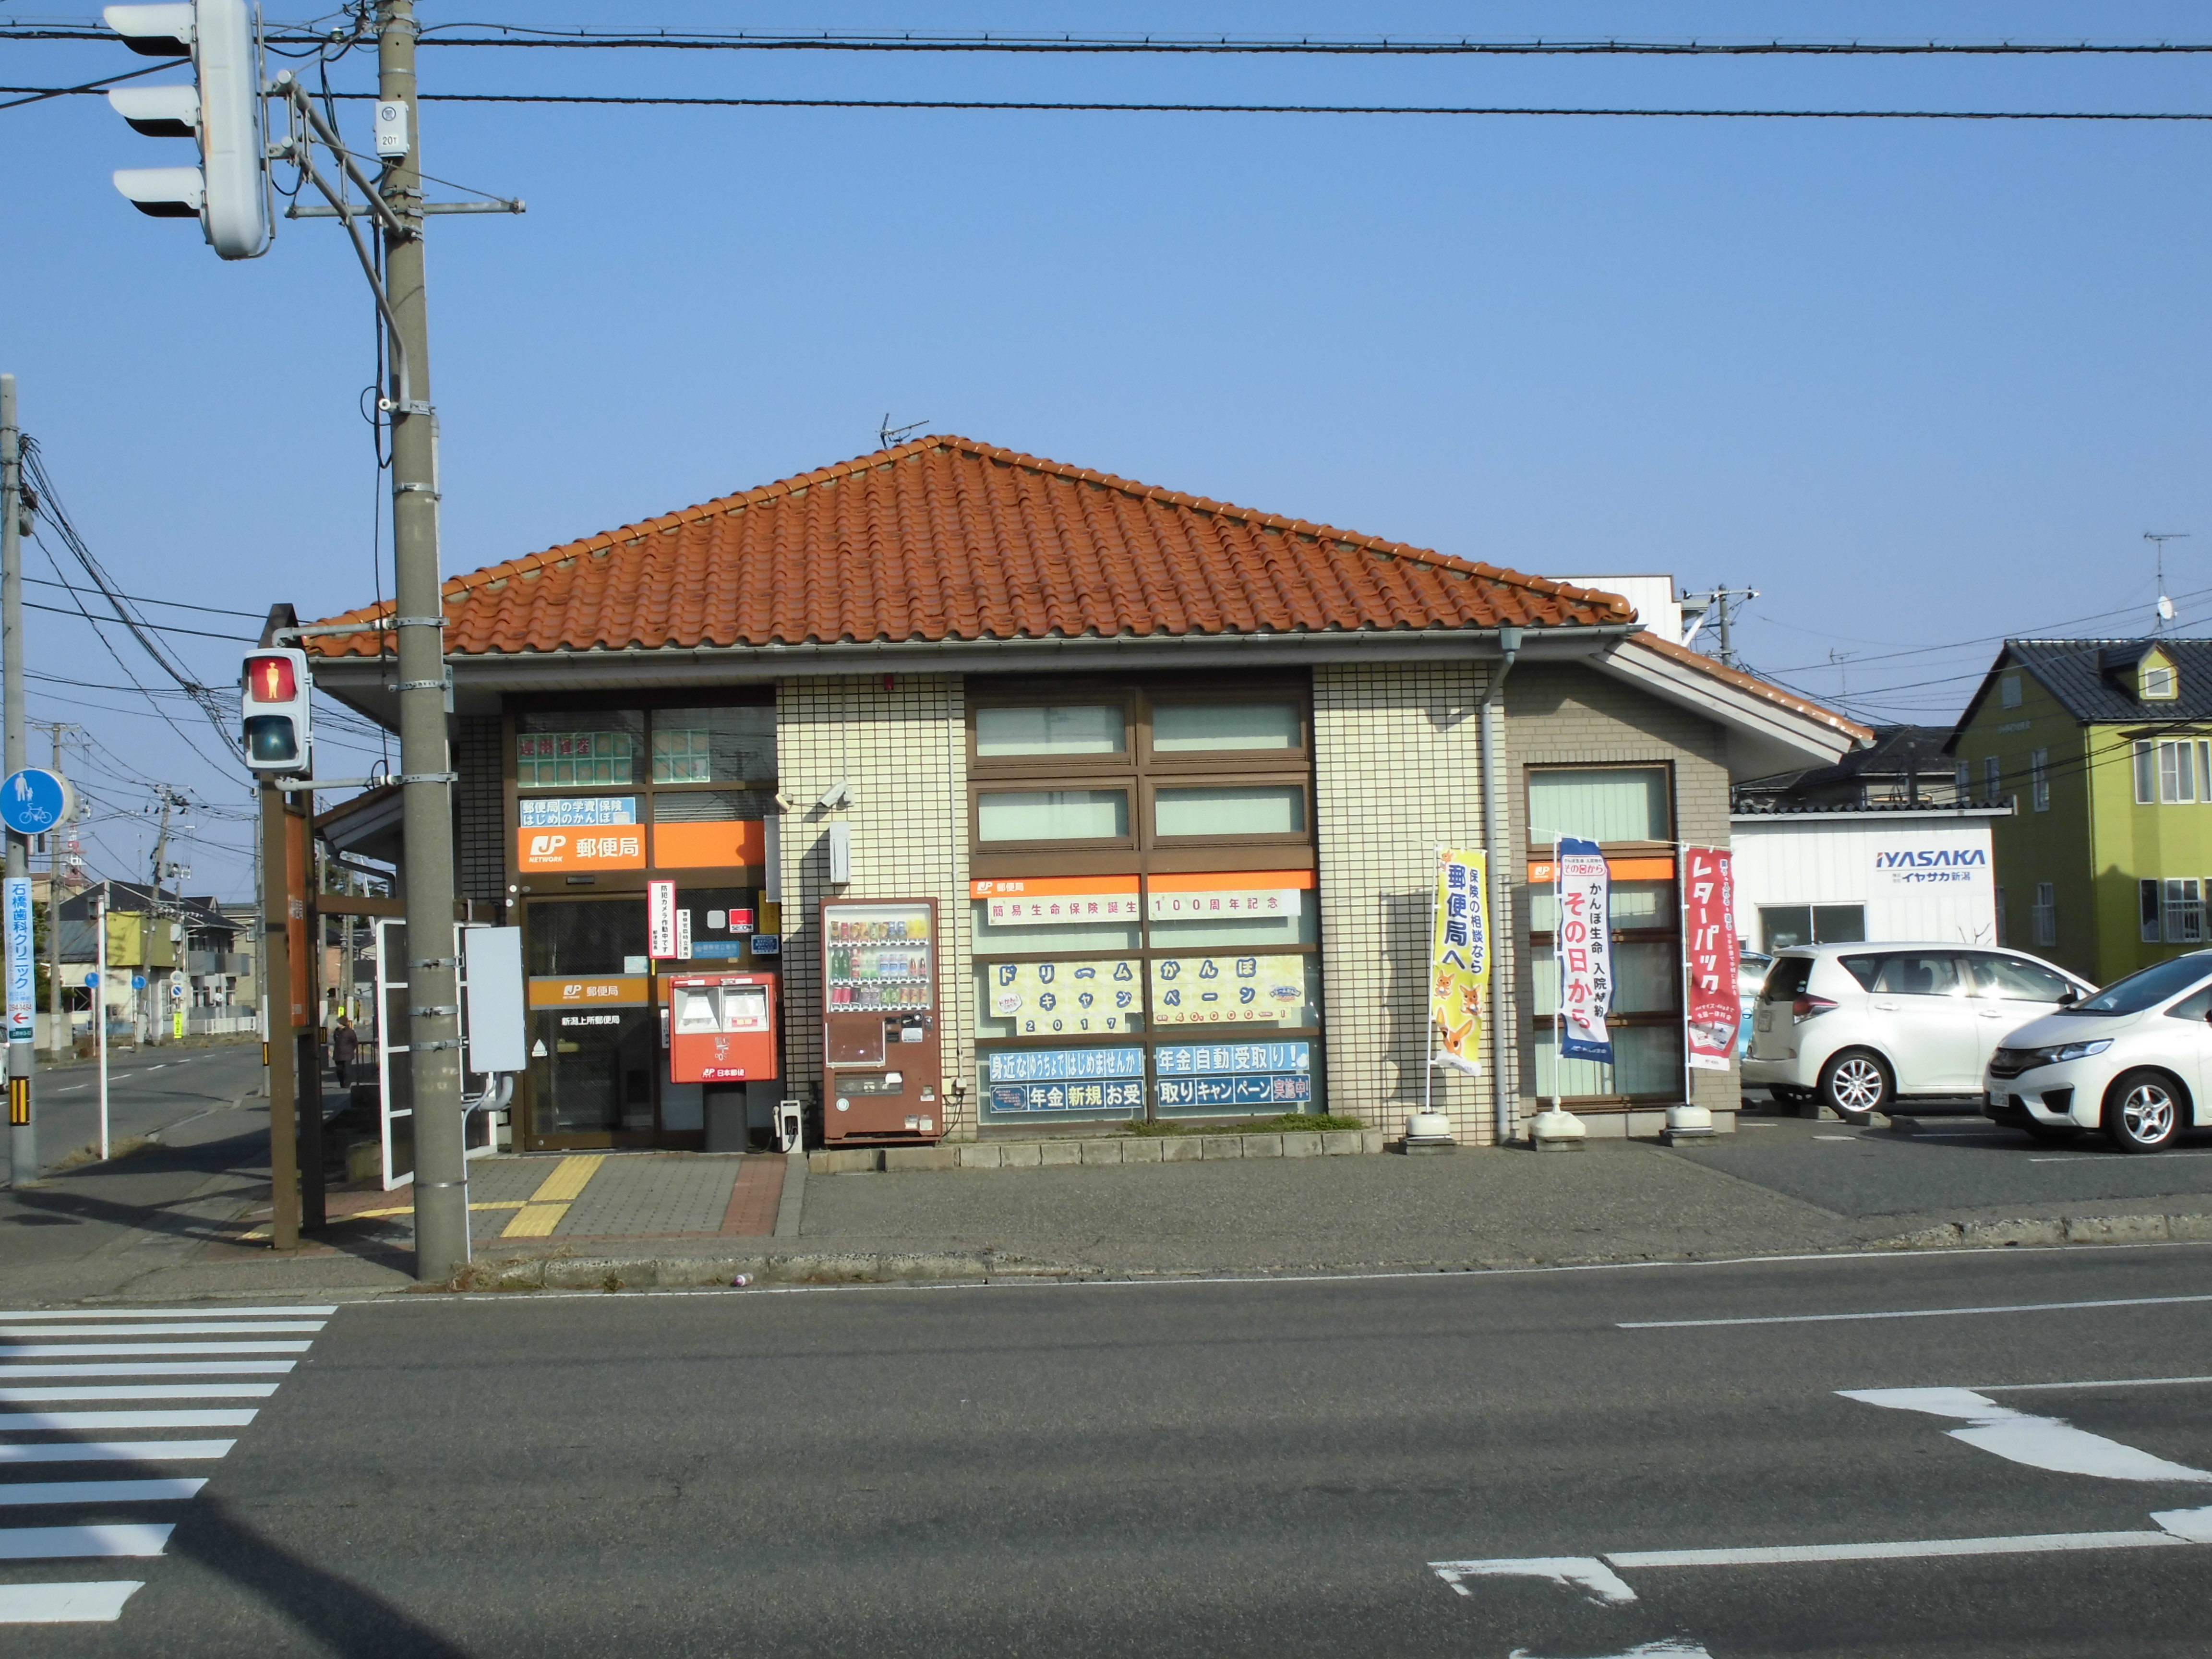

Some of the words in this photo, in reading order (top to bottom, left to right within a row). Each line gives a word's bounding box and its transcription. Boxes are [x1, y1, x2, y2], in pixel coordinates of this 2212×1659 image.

[523, 800, 623, 814] 郵便局の学資保険
[530, 835, 566, 855] JP
[576, 837, 638, 858] 郵便局
[1902, 872, 1971, 882] イヤサカ新潟
[993, 901, 1137, 917] 簡易生命保険誕生
[1442, 864, 1468, 970] 郵便局へ
[1589, 883, 1603, 954] かんぽ生命
[1469, 869, 1484, 974] 保険の相談なら
[1693, 856, 1719, 994] レターパック
[12, 884, 29, 989] 石橋歯科クリニック
[1564, 892, 1593, 1029] その日から
[999, 962, 1133, 986] ドリーム
[587, 986, 618, 997] 郵便局
[1593, 962, 1607, 1018] 入院特約
[561, 1015, 620, 1025] 新潟上所郵便局
[1026, 1017, 1116, 1032] 2017
[717, 1069, 745, 1077] 日本郵便
